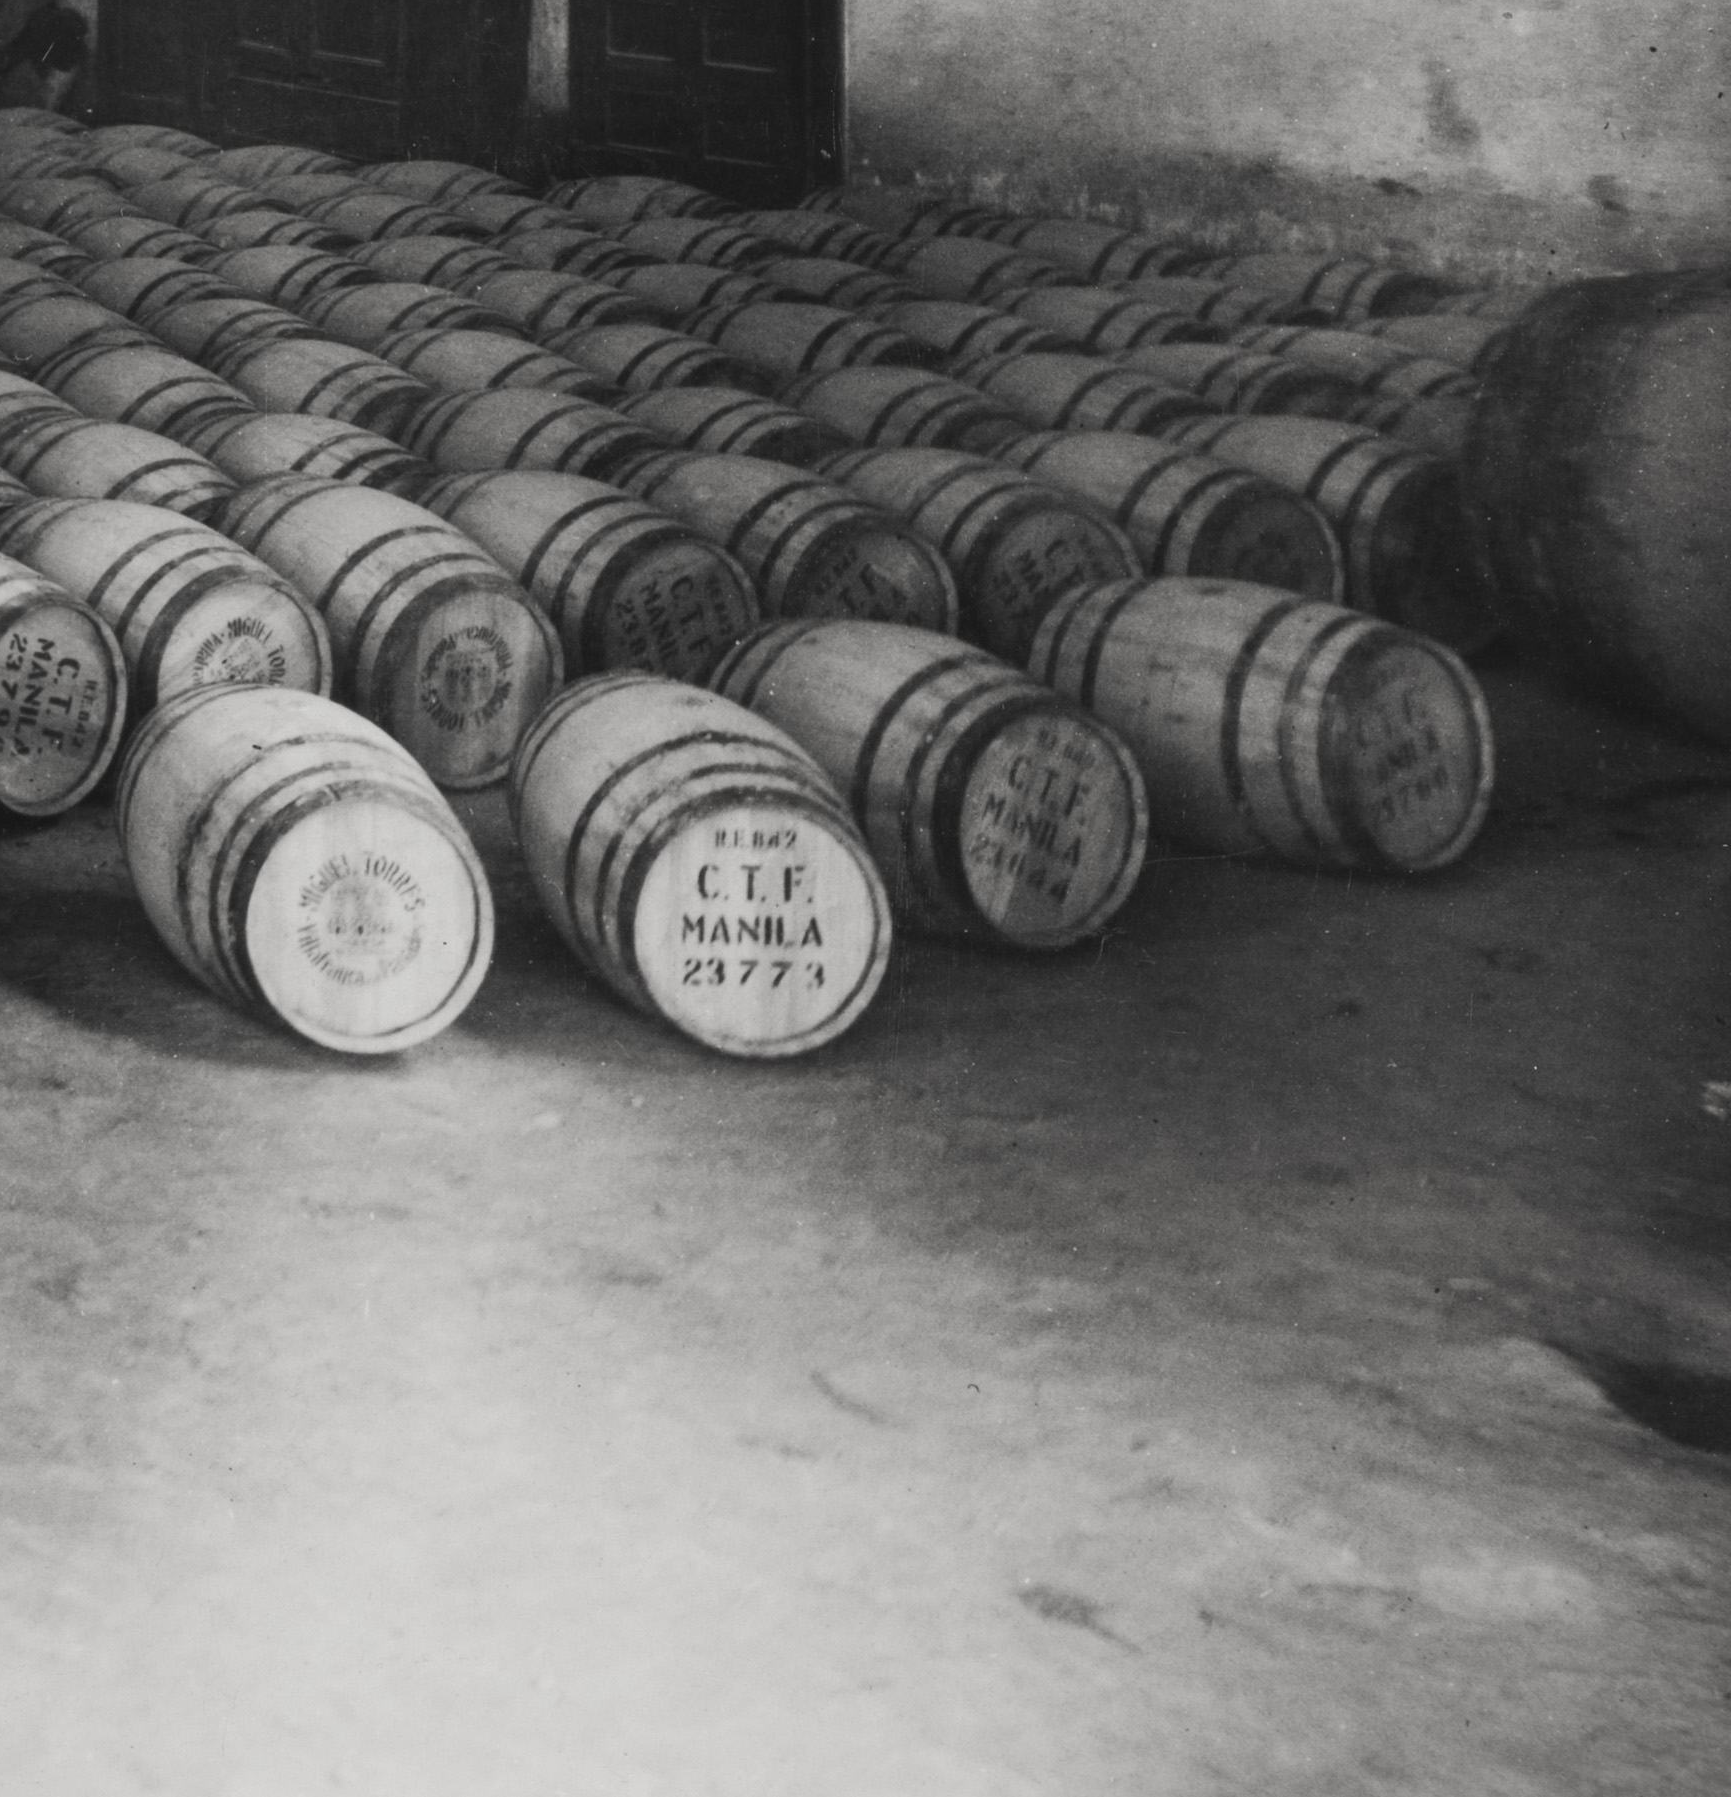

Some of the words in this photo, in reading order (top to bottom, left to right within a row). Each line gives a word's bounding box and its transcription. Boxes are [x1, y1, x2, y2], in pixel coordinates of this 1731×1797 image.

[10, 637, 55, 757] MANILA
[982, 793, 1083, 868] MANILA
[363, 850, 426, 912] TORRES
[682, 915, 823, 948] MANILA
[682, 958, 826, 989] 23773
